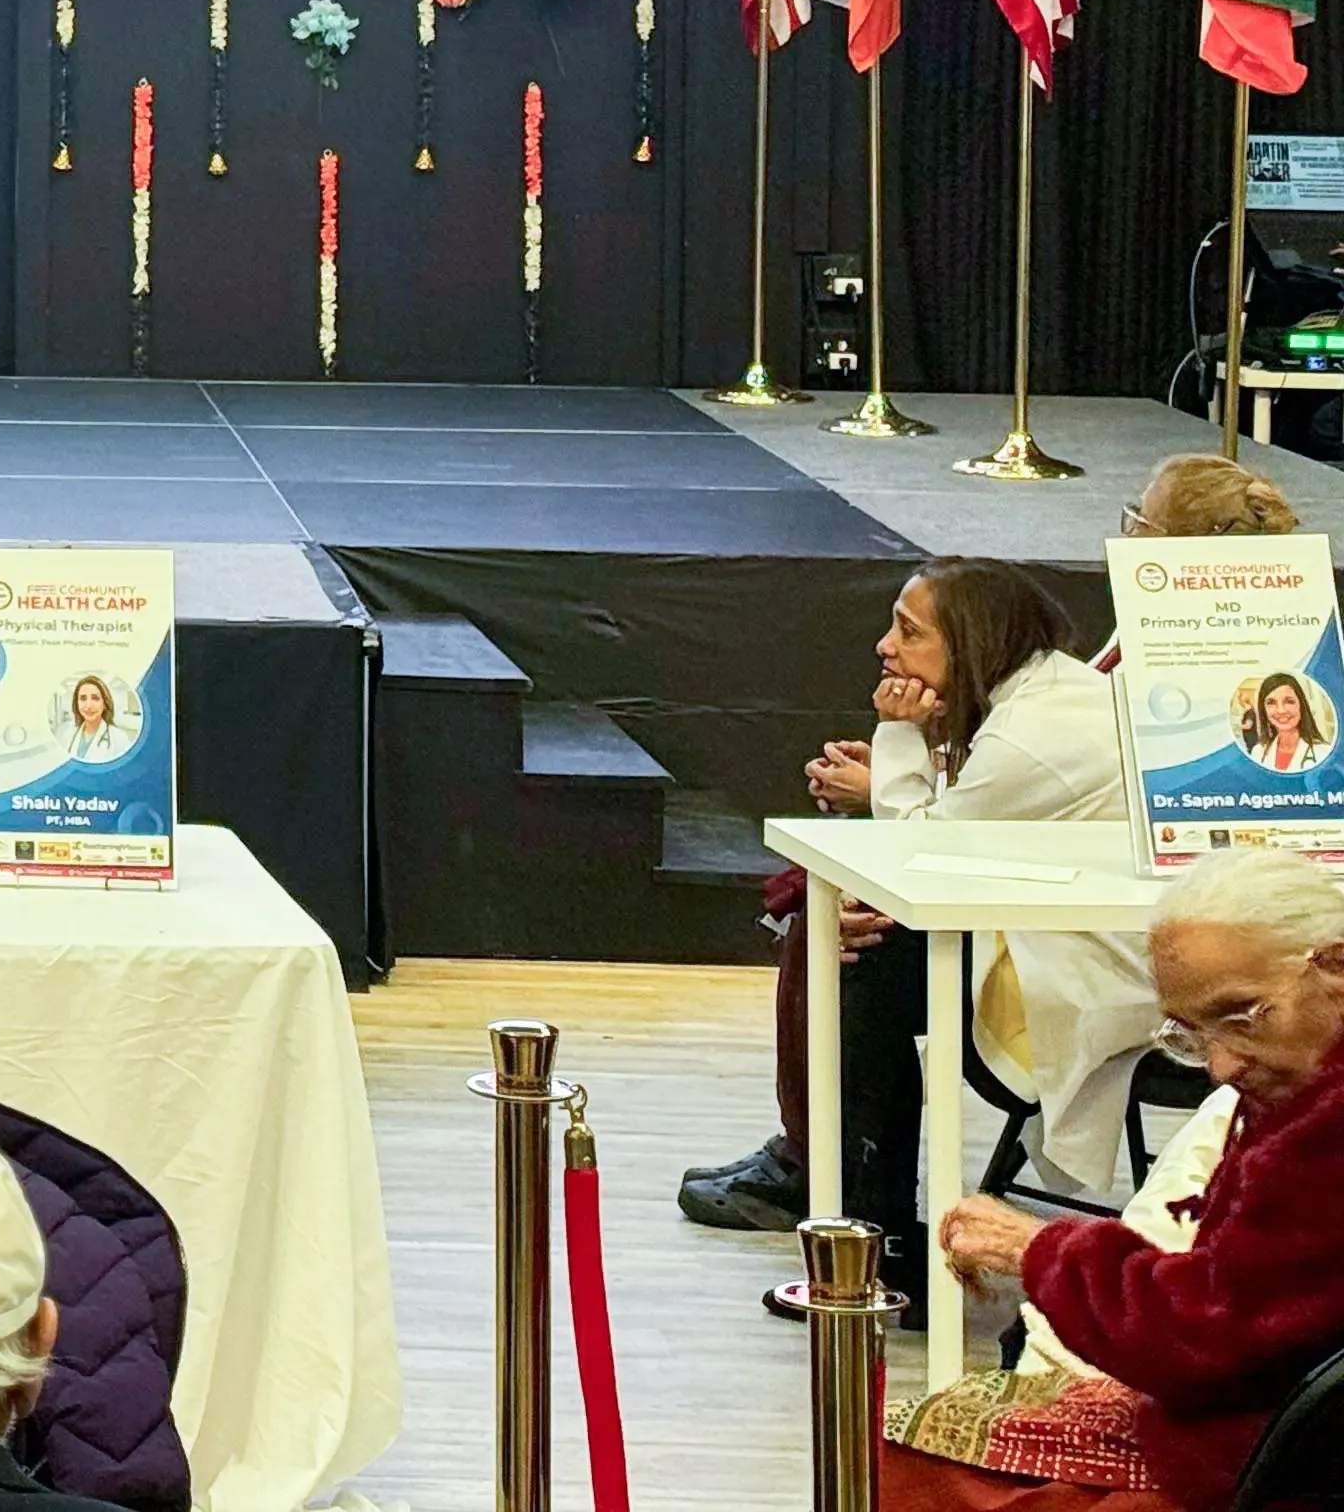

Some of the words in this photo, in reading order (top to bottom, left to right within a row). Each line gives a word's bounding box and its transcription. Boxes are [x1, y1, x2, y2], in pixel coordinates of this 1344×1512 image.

[1180, 564, 1211, 576] FREE
[1212, 563, 1292, 575] COMMUNITY
[58, 584, 137, 597] COMMUNITY
[1172, 575, 1247, 591] HEALTH
[1249, 574, 1305, 590] CAMP
[16, 595, 90, 611] HEALTH
[92, 596, 148, 612] CAMP
[1214, 601, 1242, 614] MD
[60, 619, 134, 635] Therapist
[1139, 616, 1202, 631] Primary
[1205, 616, 1242, 628] Care
[1245, 613, 1321, 630] Physician
[11, 794, 62, 812] Shalu
[64, 796, 120, 813] Yadav
[1152, 793, 1180, 809] Dr.
[1181, 793, 1235, 811] Sapna
[1238, 791, 1325, 810] Aggarwal,
